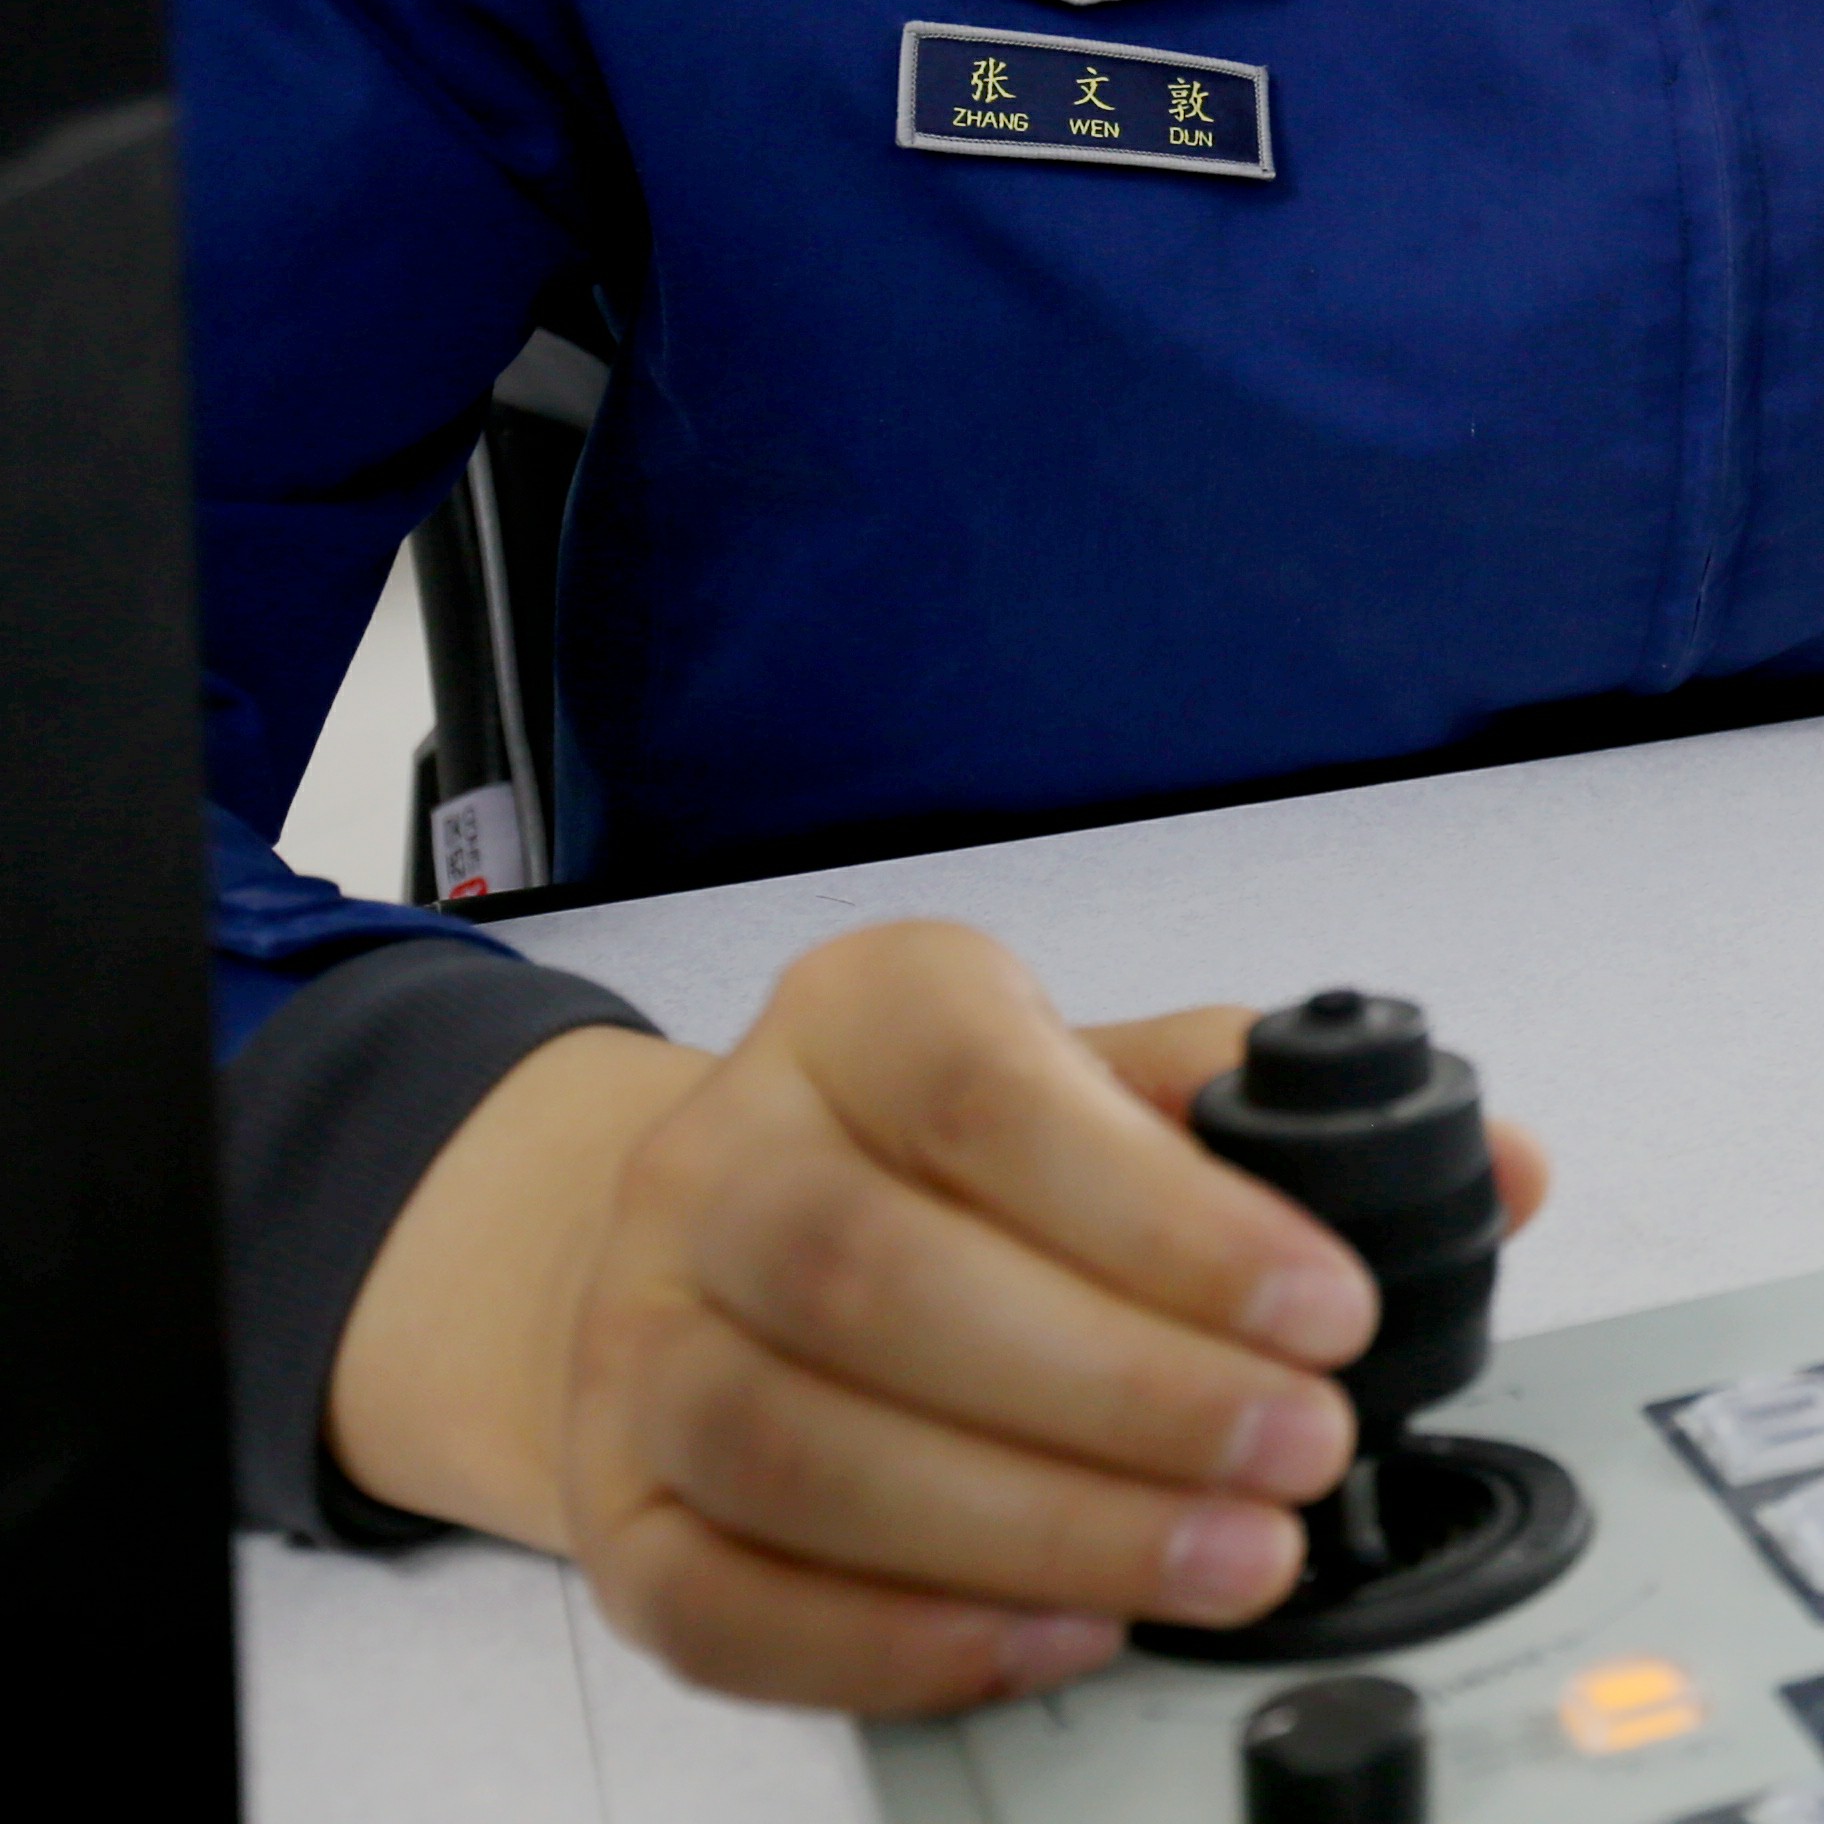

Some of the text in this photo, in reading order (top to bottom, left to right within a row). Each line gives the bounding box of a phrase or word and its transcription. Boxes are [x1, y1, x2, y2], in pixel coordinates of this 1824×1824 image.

[970, 57, 1214, 123] 张文敦
[952, 107, 1213, 147] ZHANG WEN DUN
